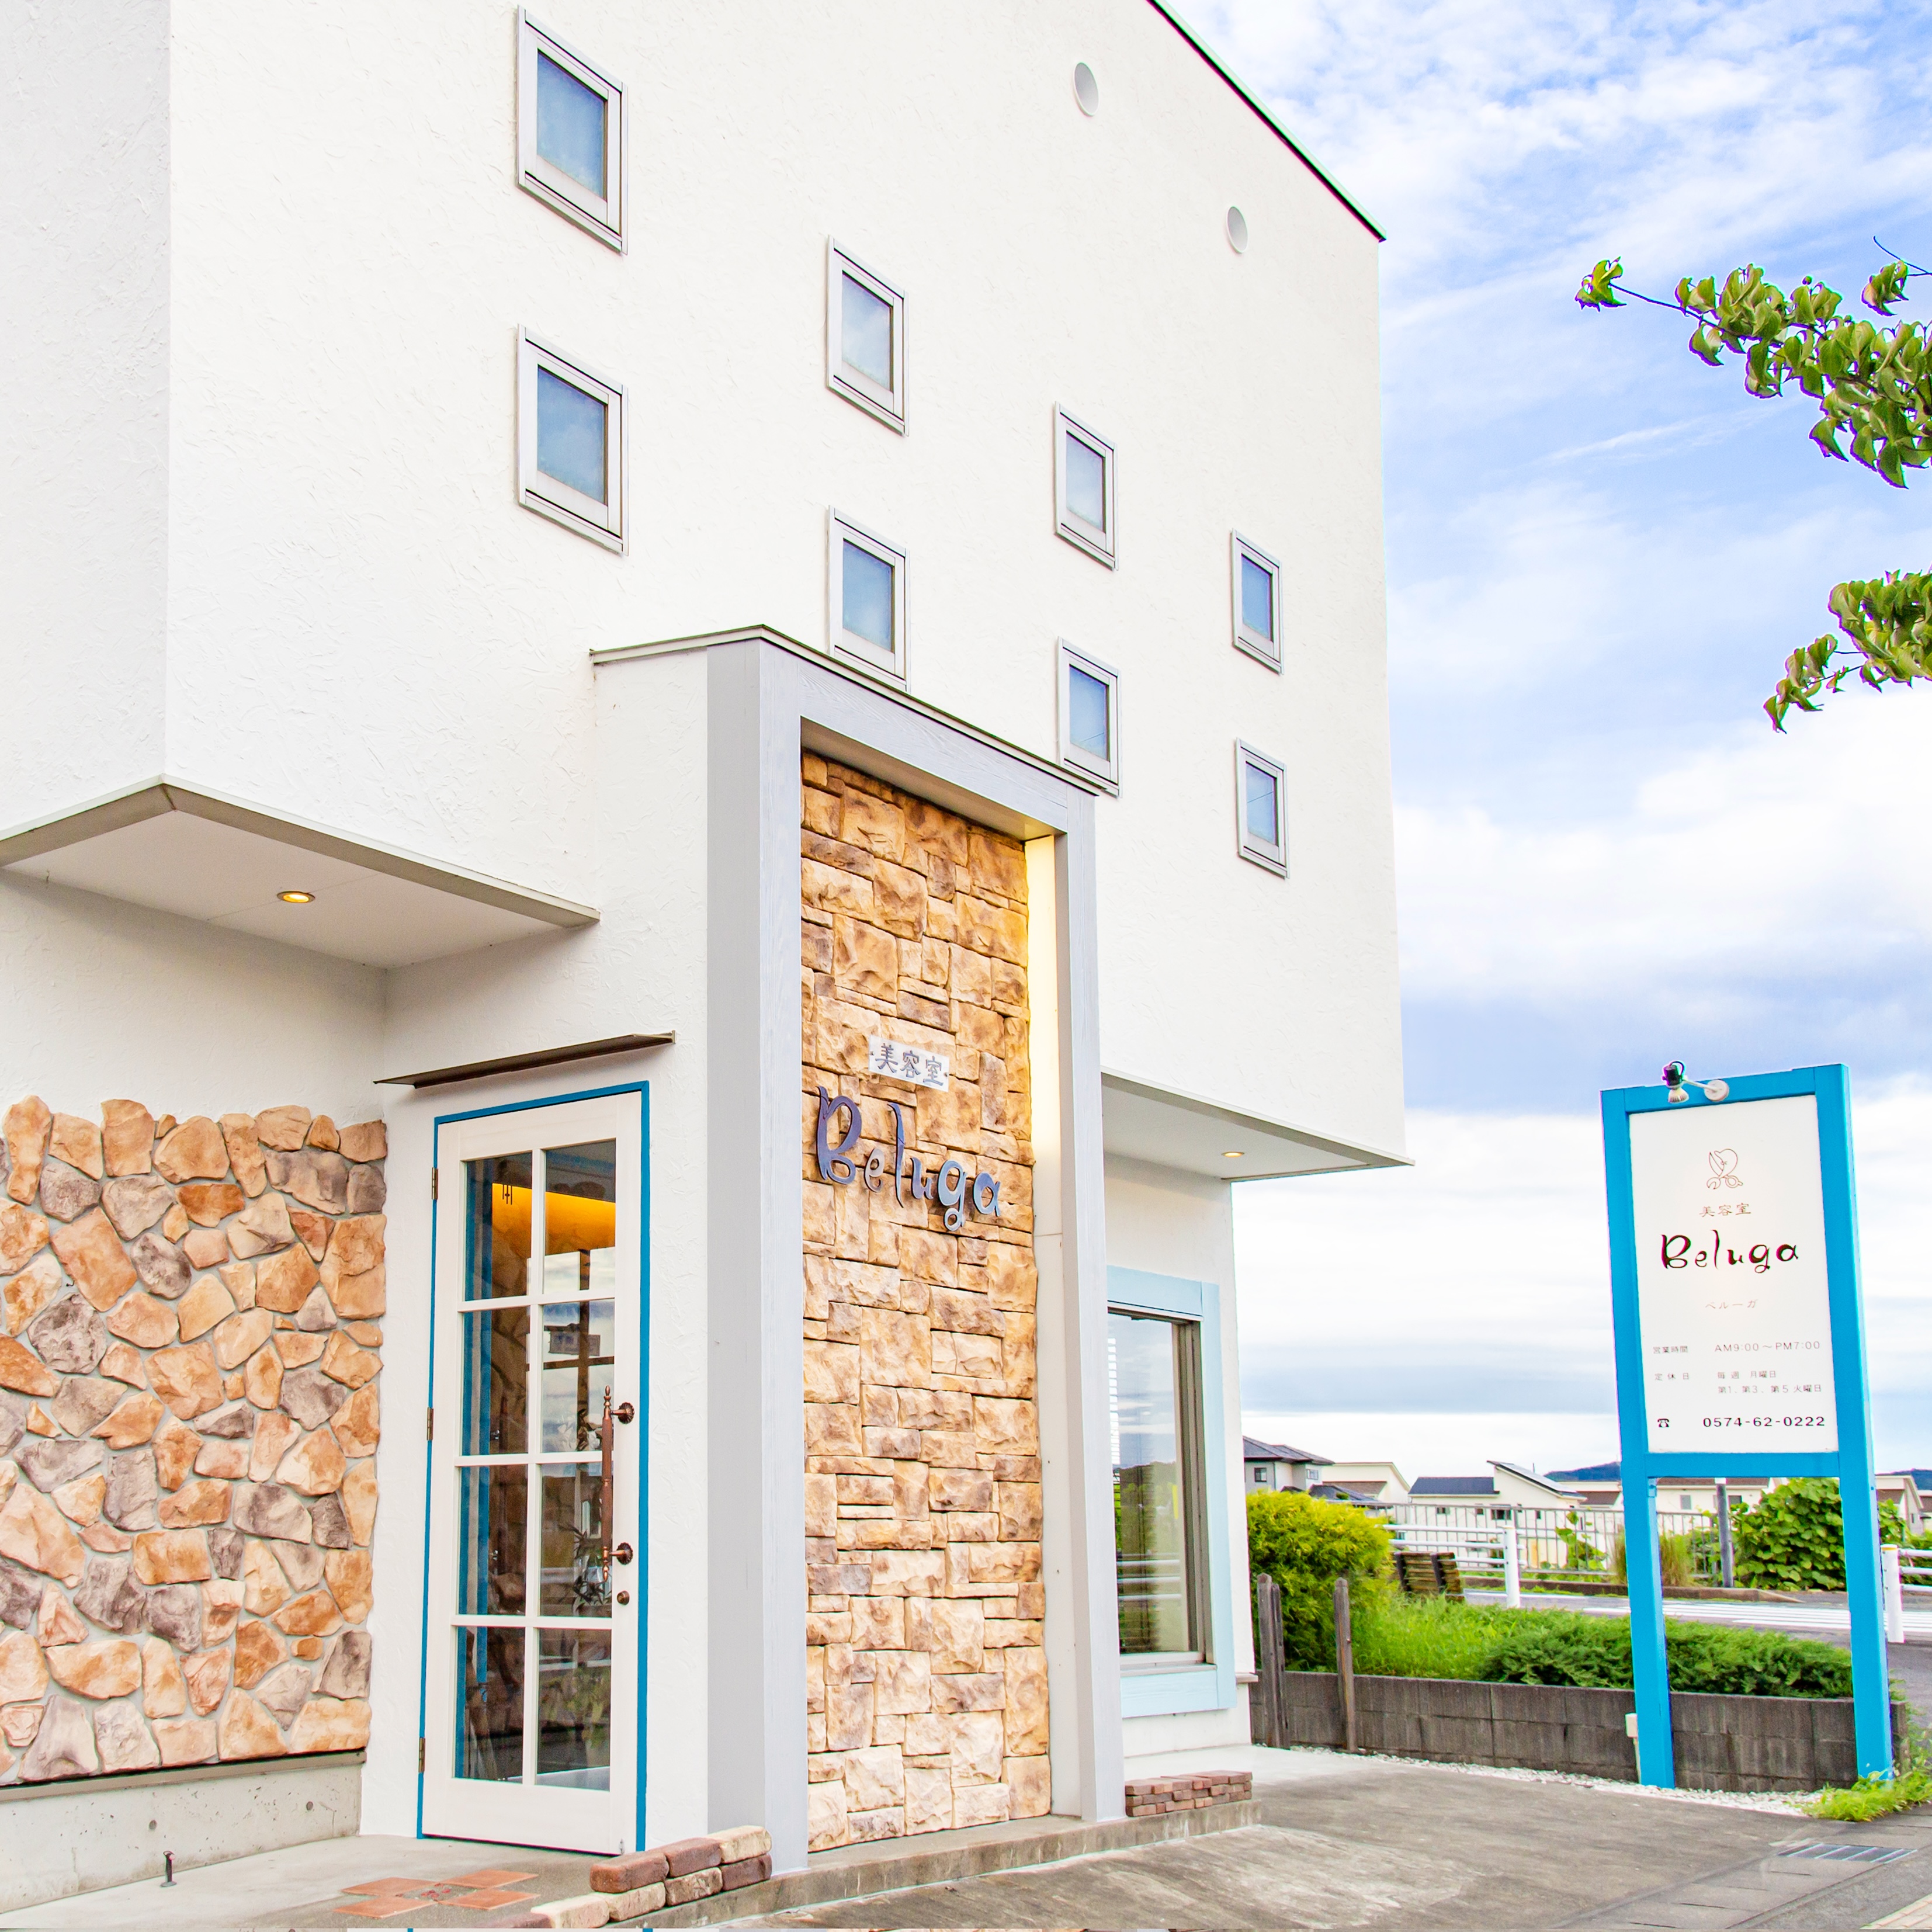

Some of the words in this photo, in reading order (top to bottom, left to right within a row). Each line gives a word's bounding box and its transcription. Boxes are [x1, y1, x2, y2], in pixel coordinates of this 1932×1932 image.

[875, 1042, 944, 1086] 美容室
[817, 1086, 1000, 1231] Beluga
[1699, 1202, 1752, 1218] 美容室
[1660, 1229, 1799, 1274] Beluga
[1705, 1300, 1757, 1309] ベルーガ
[1702, 1416, 1826, 1428] 0574-62-0222
